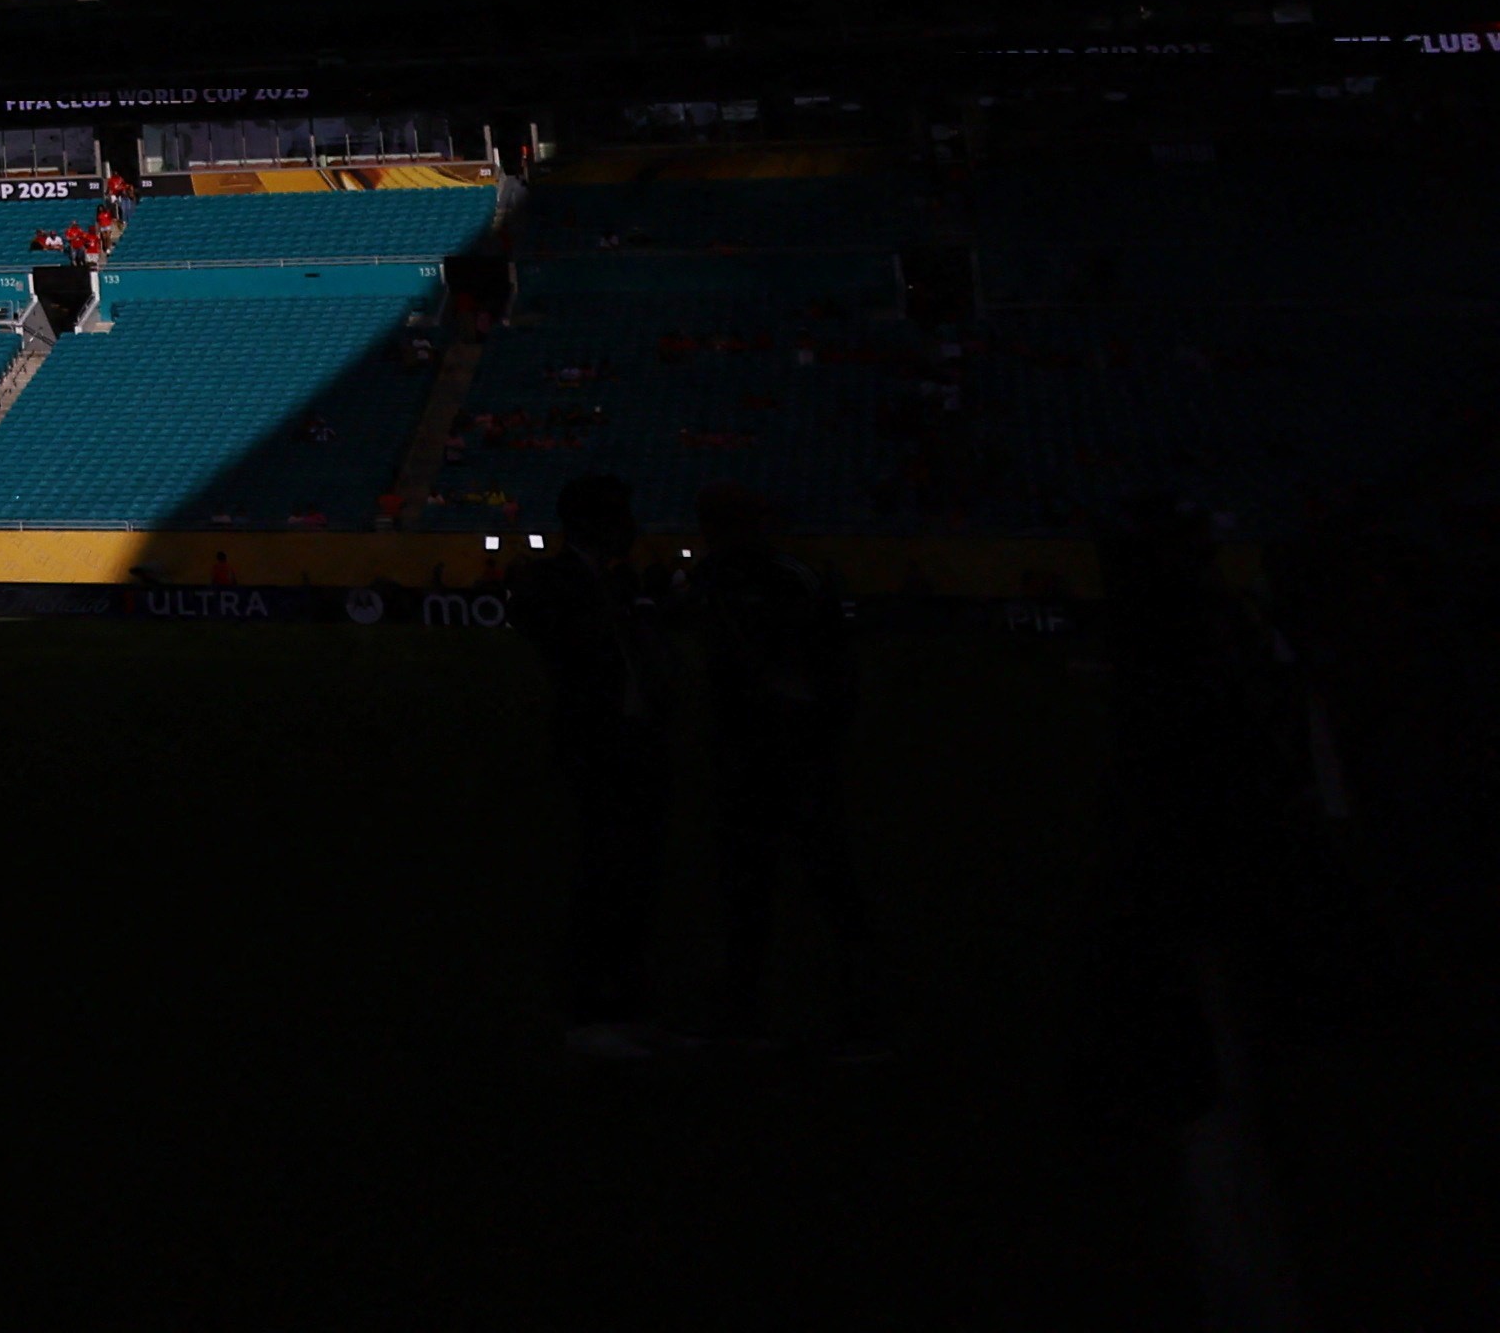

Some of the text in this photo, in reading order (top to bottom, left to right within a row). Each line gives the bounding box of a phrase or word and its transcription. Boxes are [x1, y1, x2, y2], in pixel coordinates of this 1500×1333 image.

[117, 88, 198, 107] WORLD
[419, 267, 437, 277] 133
[0, 277, 17, 287] 132
[104, 275, 119, 284] 133
[146, 589, 269, 619] ULTRA
